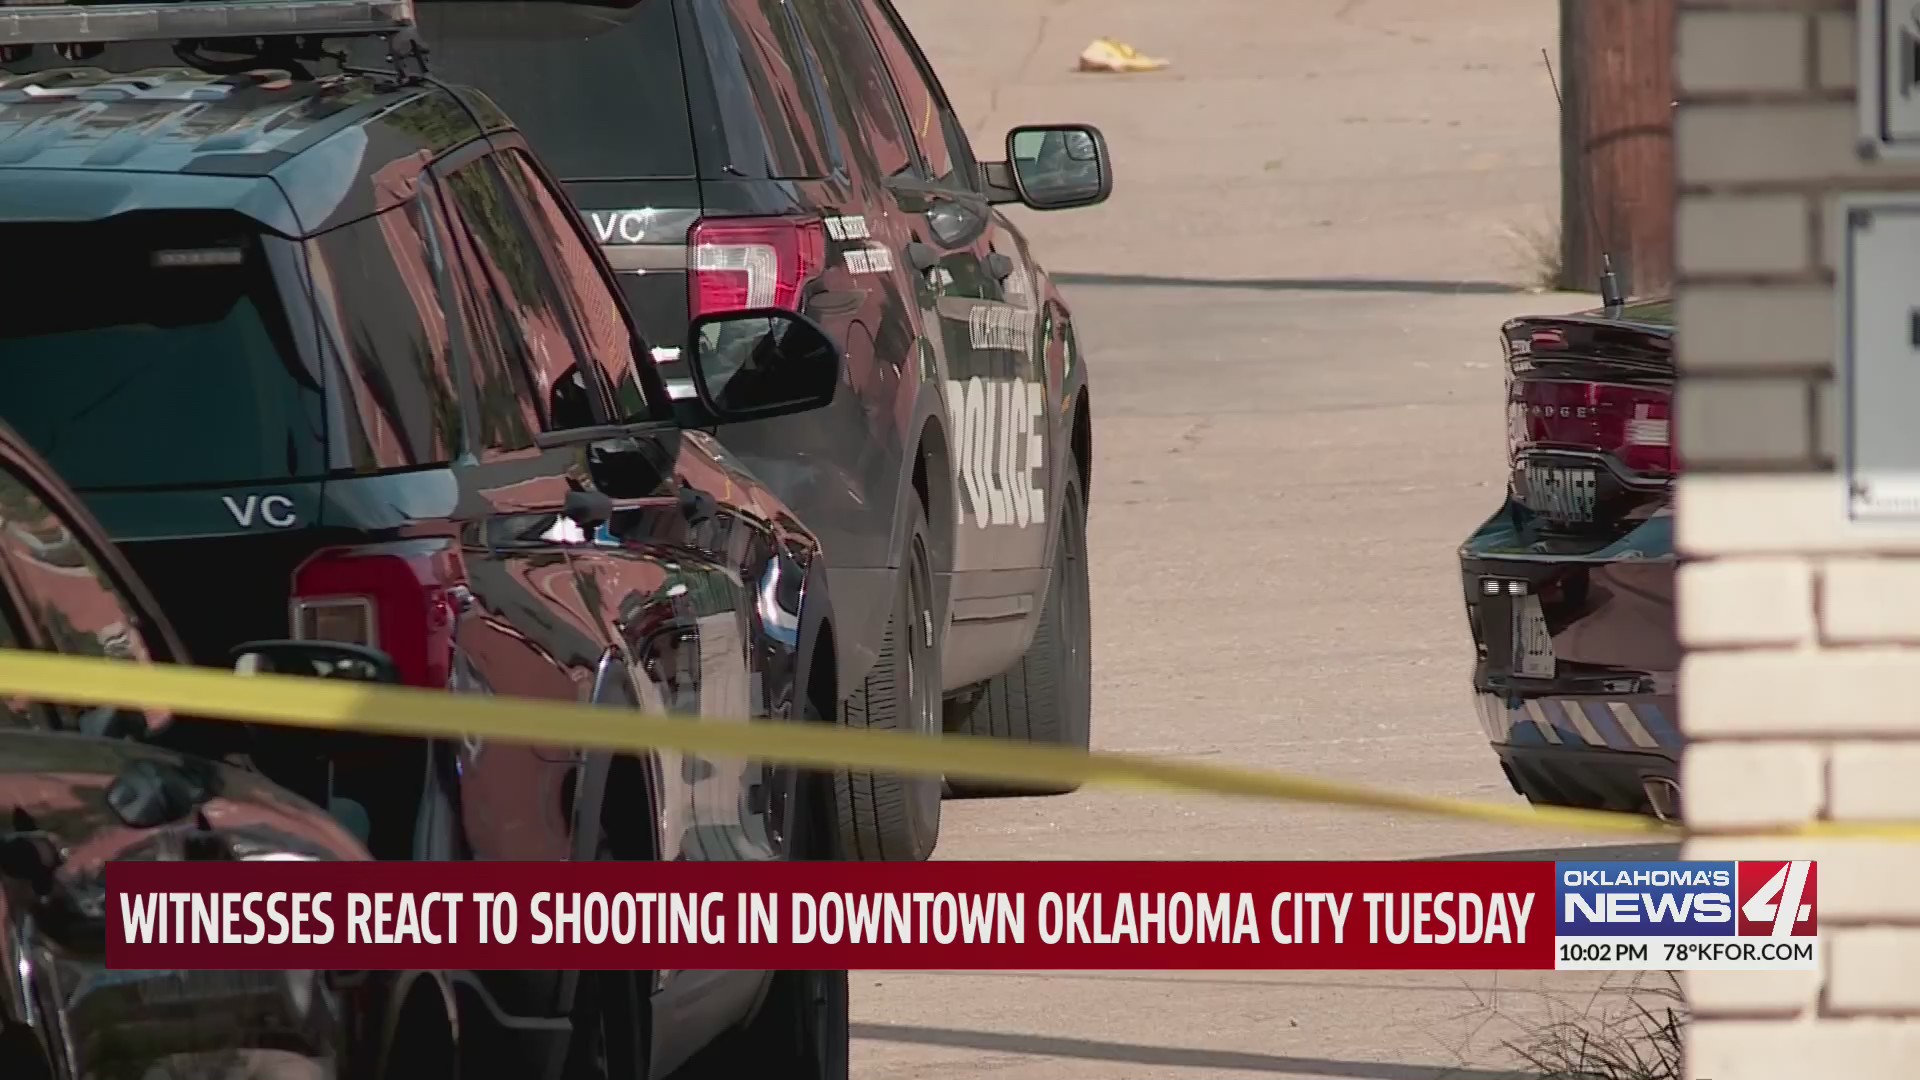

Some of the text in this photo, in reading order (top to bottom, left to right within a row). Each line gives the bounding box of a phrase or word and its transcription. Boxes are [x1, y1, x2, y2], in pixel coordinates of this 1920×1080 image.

[591, 212, 645, 243] VC
[946, 376, 1045, 529] POLICE
[222, 495, 297, 528] VC
